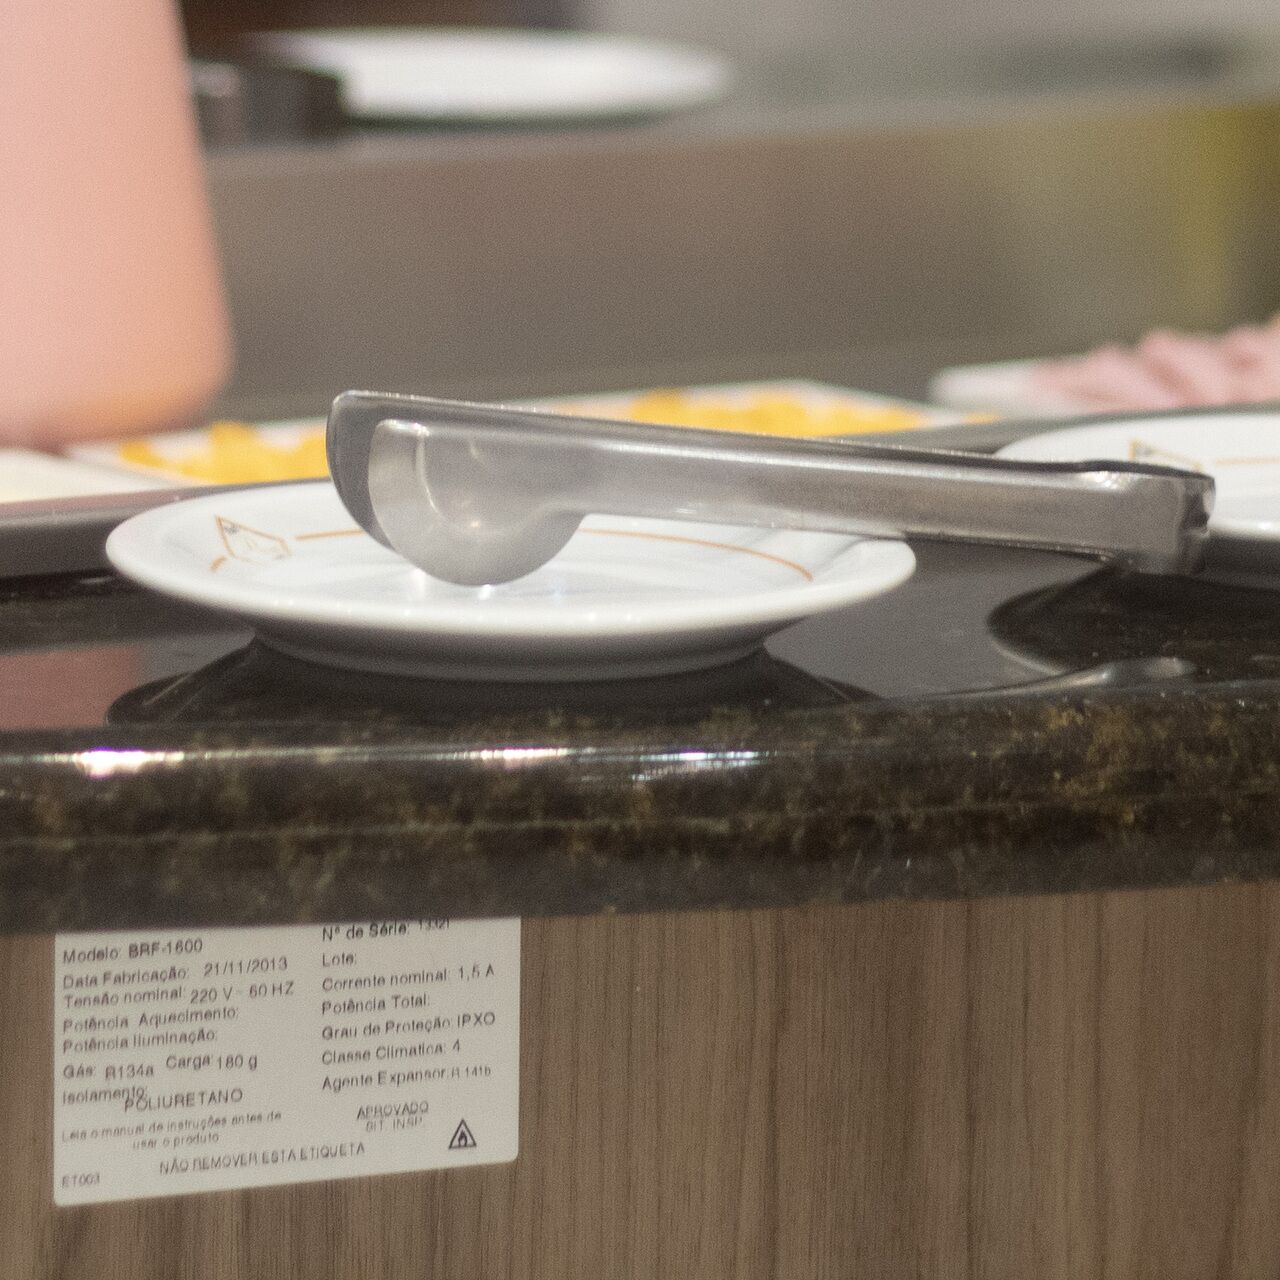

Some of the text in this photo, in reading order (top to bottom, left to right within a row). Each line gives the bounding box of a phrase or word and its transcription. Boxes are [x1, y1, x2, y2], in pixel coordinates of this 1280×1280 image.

[346, 924, 363, 939] de
[63, 938, 203, 964] Modelo: BRF-1600
[322, 951, 357, 967] Lote:
[63, 956, 288, 990] Data Fabricação: 21/11/2013
[322, 974, 386, 992] Corrente
[390, 968, 450, 986] nominal:
[485, 963, 495, 977] A
[64, 993, 119, 1009] Tensão
[124, 986, 186, 1005] nominal:
[190, 988, 217, 1005] 220
[223, 986, 233, 1001] V
[249, 984, 267, 998] 60
[272, 980, 294, 997] HZ
[322, 993, 430, 1015] Potência Total:
[63, 1006, 239, 1034] Potência Aquecimento:
[322, 1026, 357, 1041] Grau
[363, 1024, 380, 1038] de
[385, 1016, 453, 1034] Proteção:
[63, 1036, 128, 1055] Potência
[321, 1050, 370, 1066] Classe
[452, 1038, 461, 1053] 4
[105, 1063, 154, 1081] R134a
[165, 1054, 258, 1071] Carga: 180 g
[321, 1073, 372, 1094] Agente
[62, 1085, 243, 1112] Isolamento: POLIURETANO
[356, 1100, 429, 1120] APROVADO
[90, 1128, 99, 1138] o
[101, 1122, 145, 1139] manual
[148, 1120, 163, 1134] de
[167, 1114, 227, 1132] instruções
[231, 1111, 263, 1127] antes
[173, 1132, 220, 1150] produto
[159, 1142, 365, 1175] NÃO REMOVER ESTA ETIQUETA
